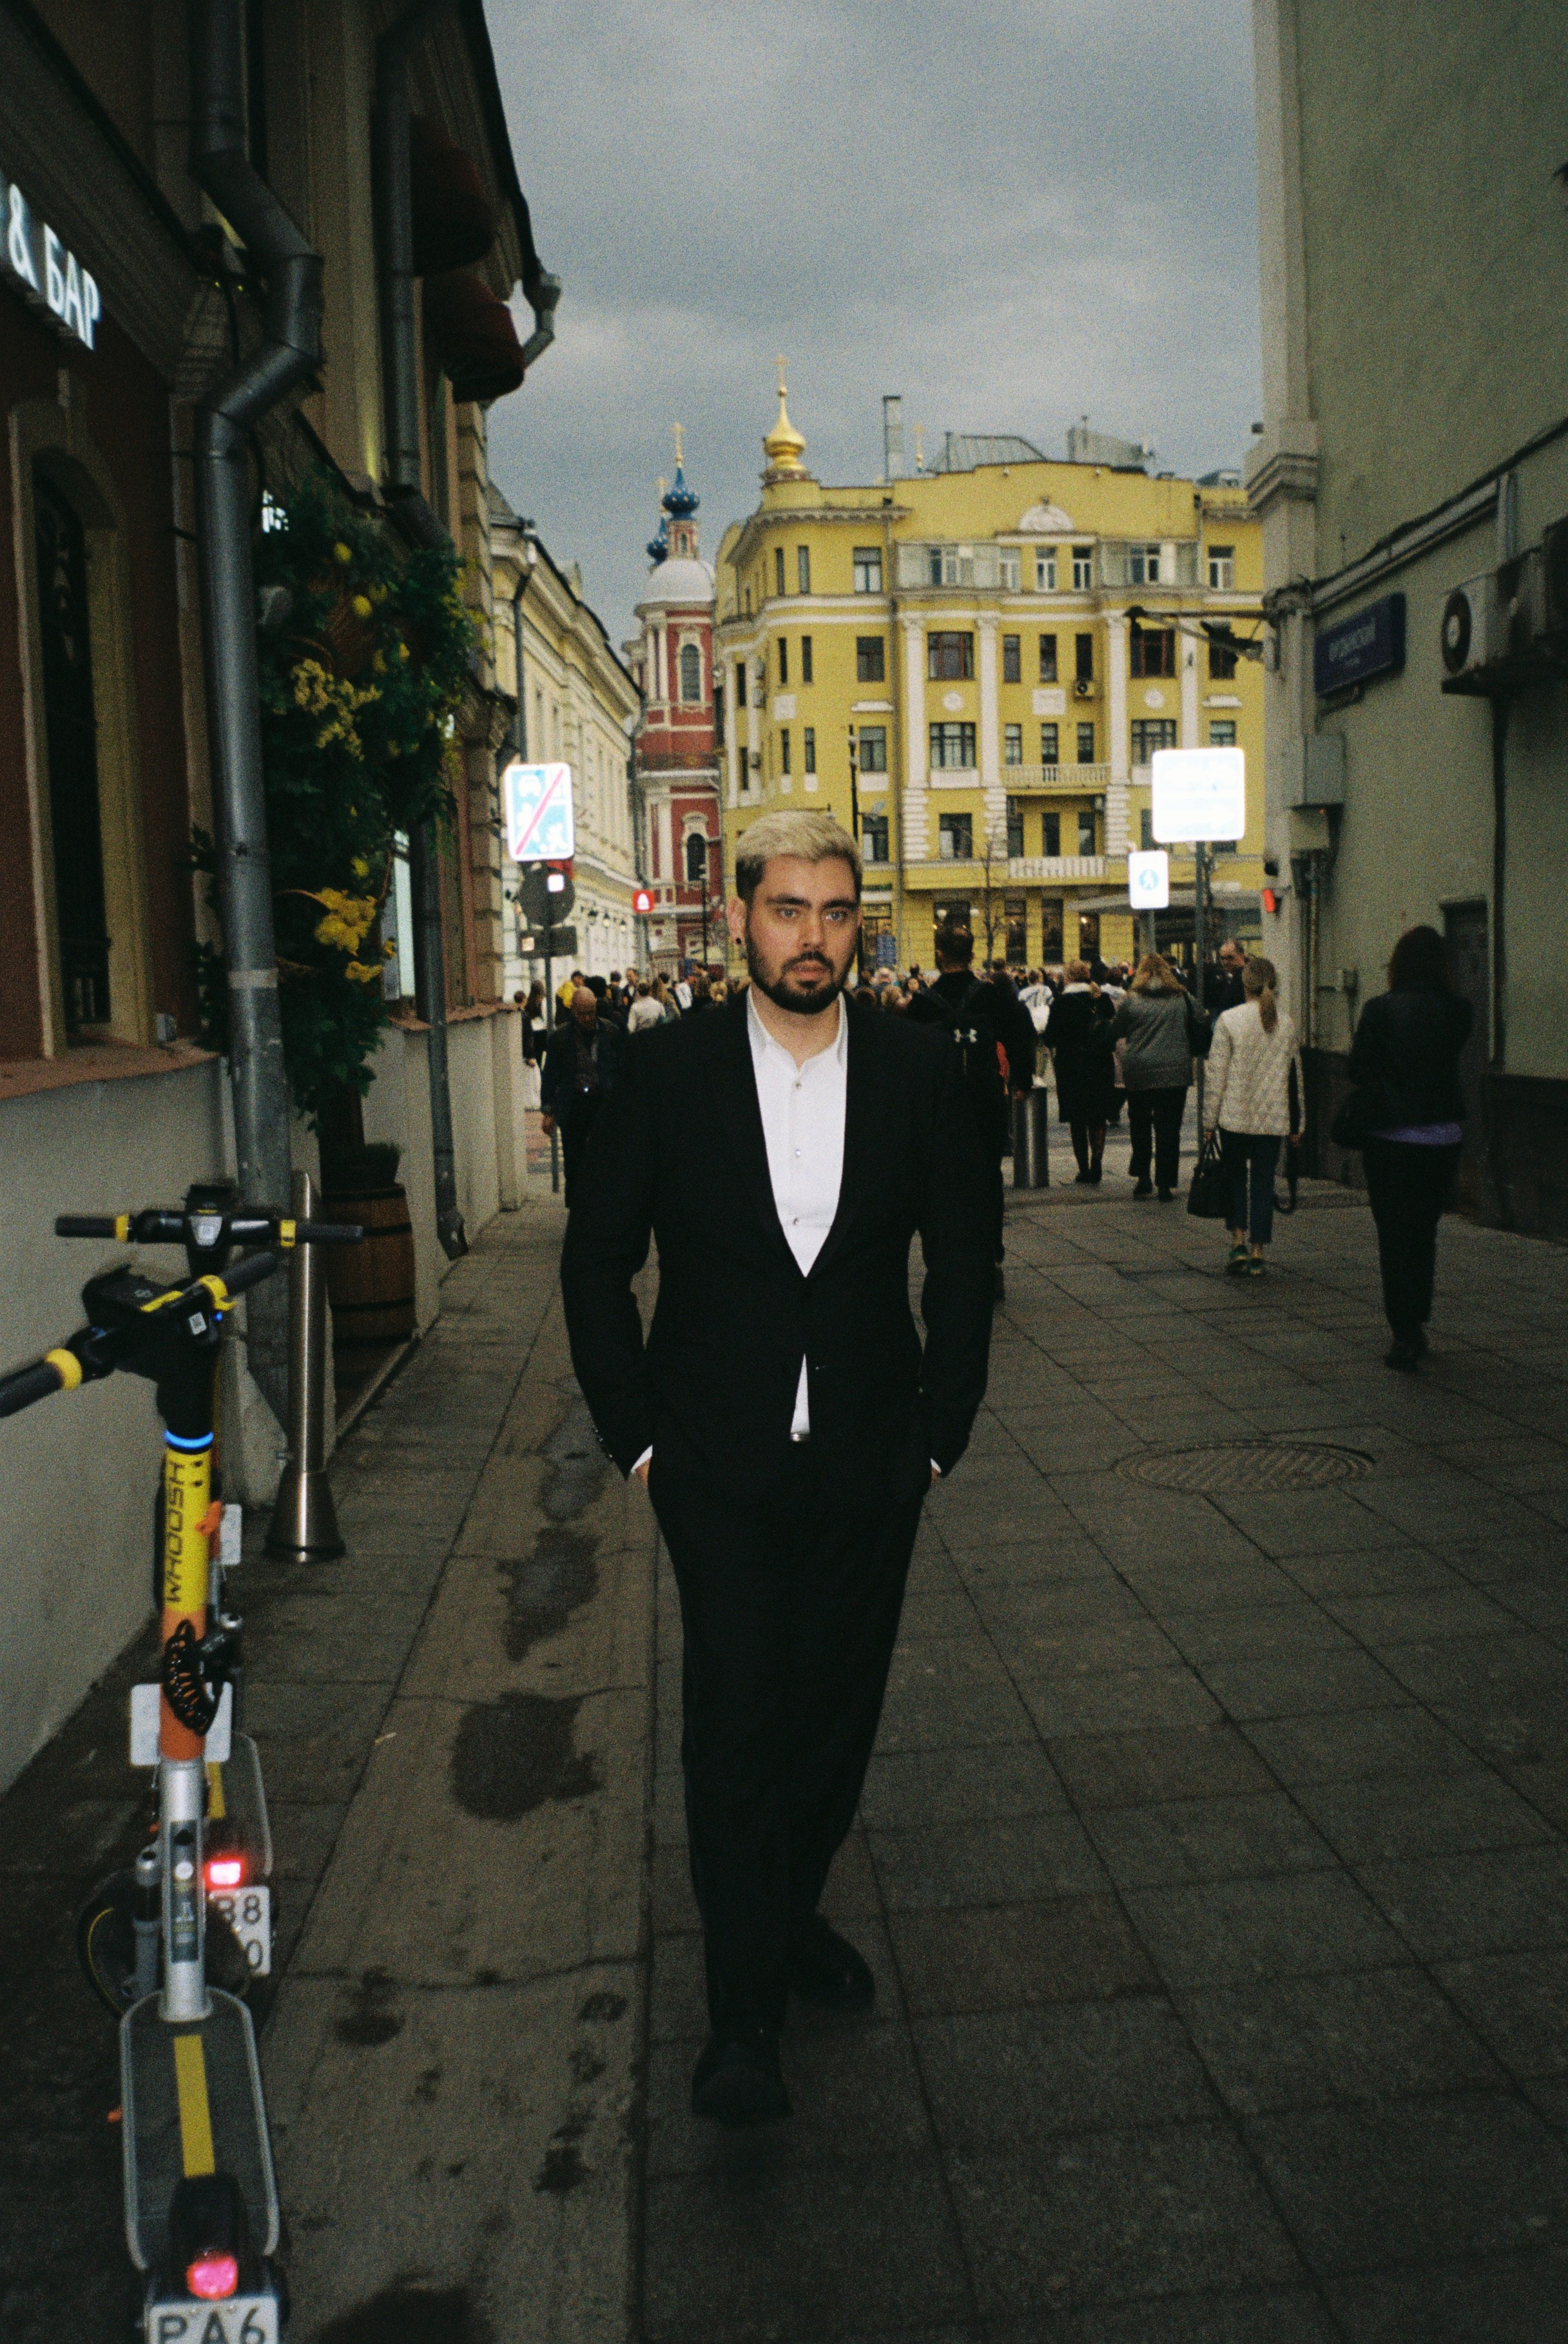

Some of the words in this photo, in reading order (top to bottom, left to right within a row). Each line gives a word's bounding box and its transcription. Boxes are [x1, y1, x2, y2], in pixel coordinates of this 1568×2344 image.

[8, 183, 41, 293] &
[44, 222, 99, 351] БАР
[166, 1459, 185, 1603] WHOOSH
